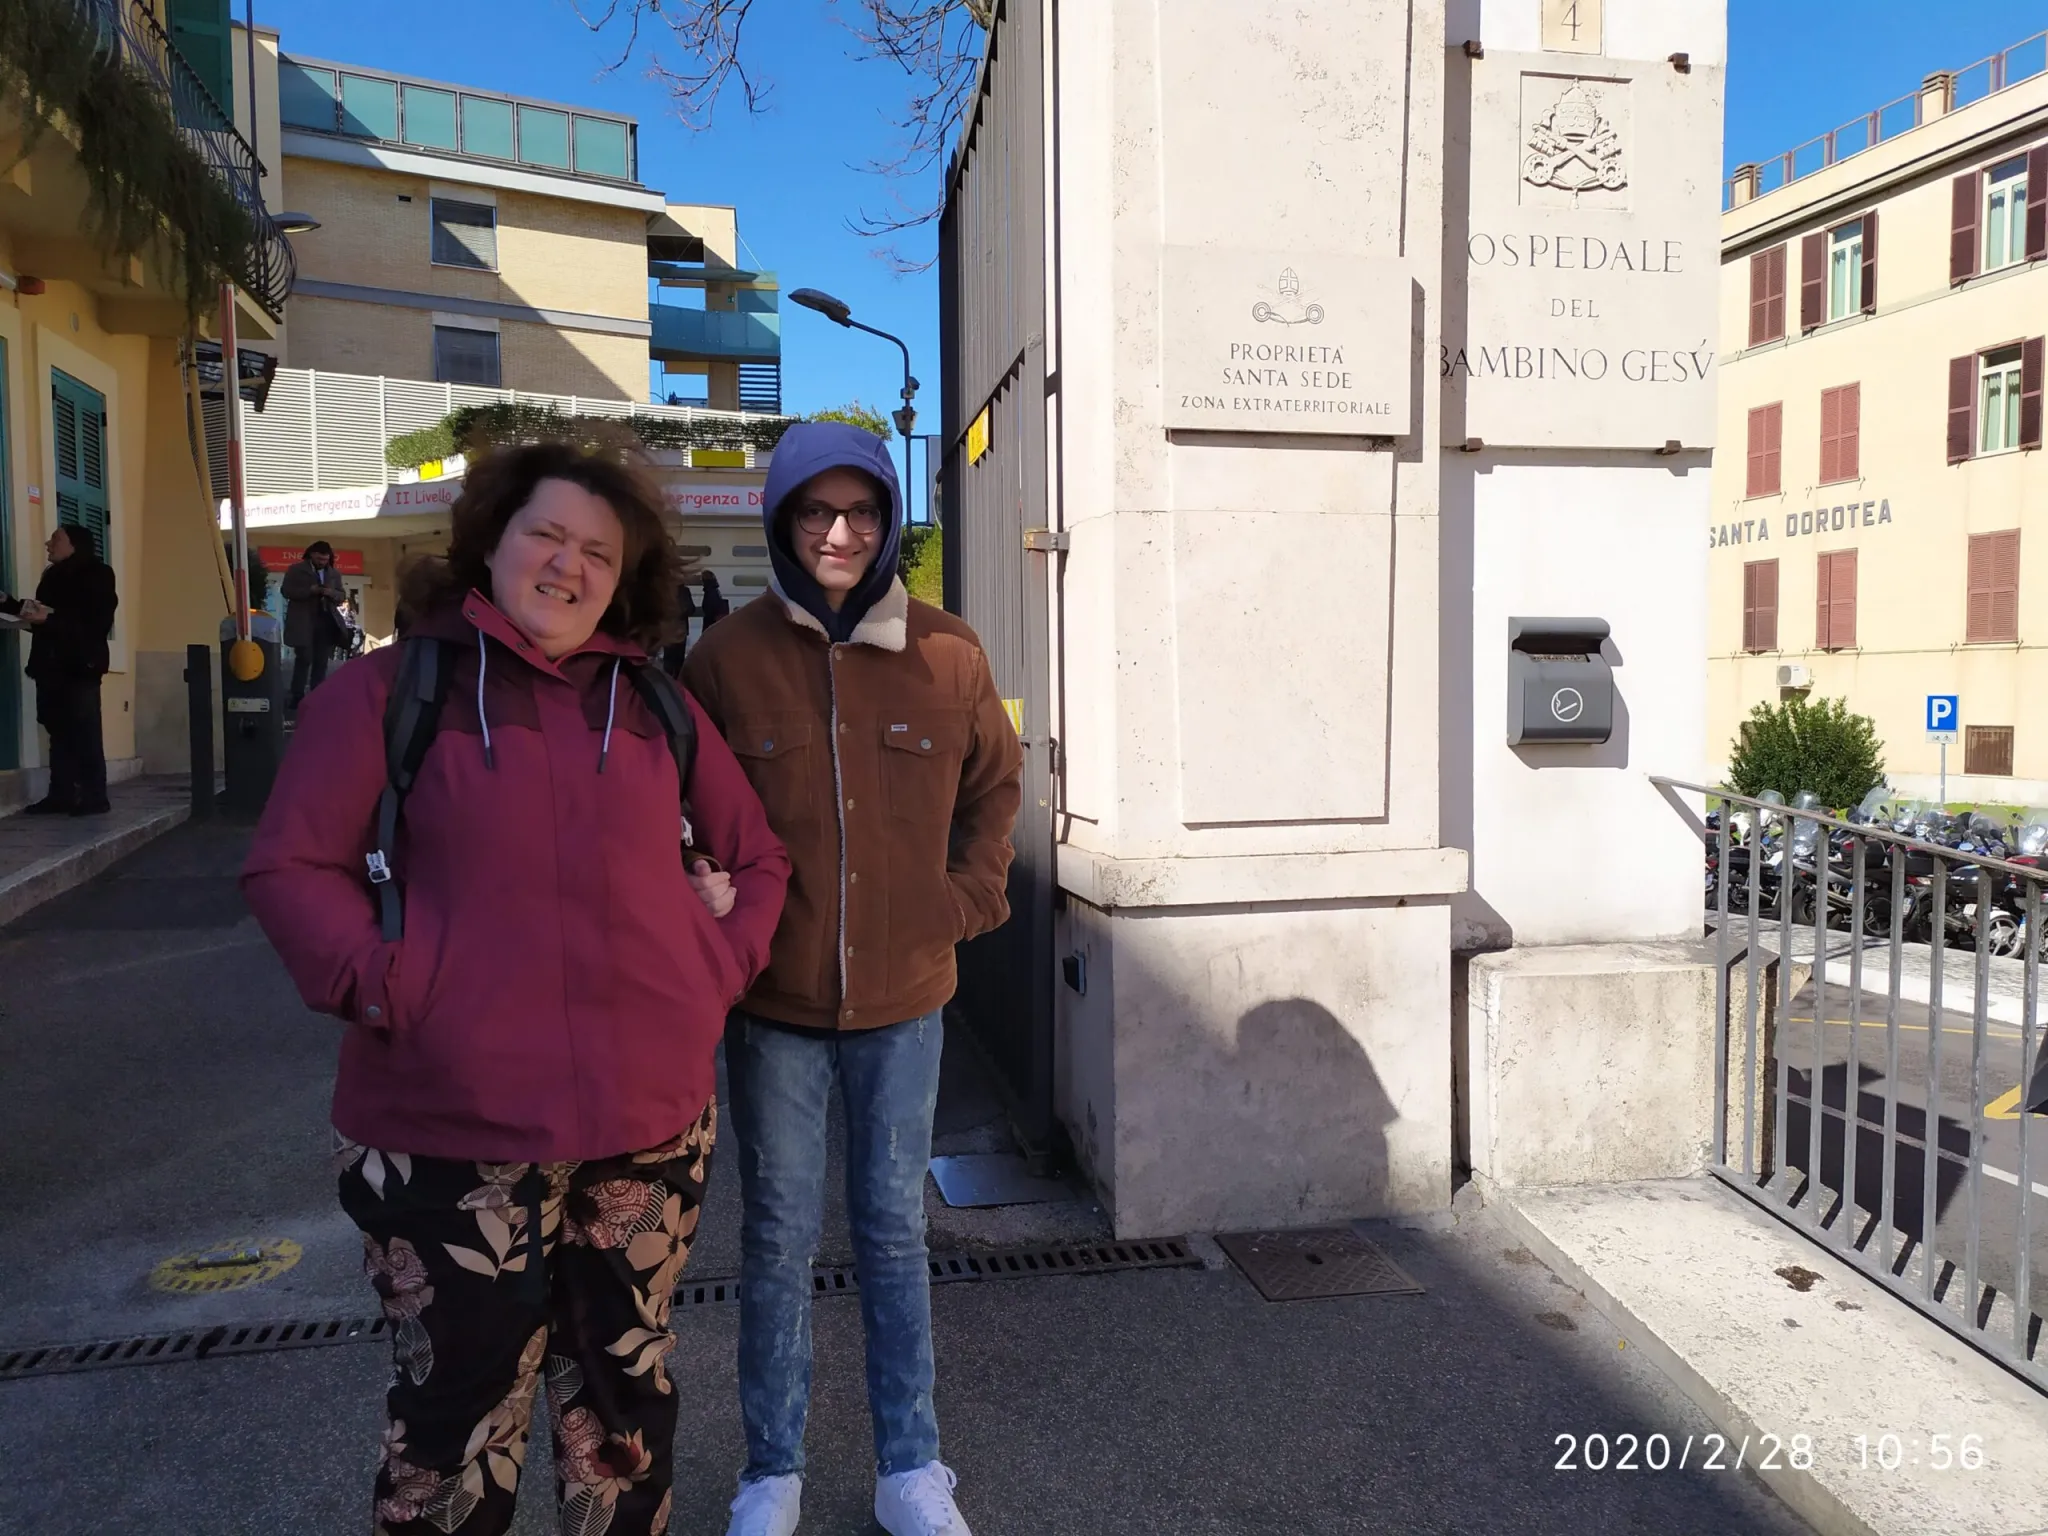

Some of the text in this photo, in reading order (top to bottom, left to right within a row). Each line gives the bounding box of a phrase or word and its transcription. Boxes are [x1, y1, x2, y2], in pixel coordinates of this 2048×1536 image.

[1561, 1, 1583, 41] 4
[1468, 233, 1683, 273] OSPEDALE
[1551, 298, 1600, 318] DEL
[1222, 367, 1353, 389] SANTA SEDE
[1181, 395, 1392, 415] ZONA EXTRATERRITORIALE
[300, 499, 360, 516] Emergenza
[366, 491, 390, 508] DEA
[416, 487, 452, 505] Livello
[1786, 498, 1892, 538] DOROTEA
[1932, 698, 1952, 727] P
